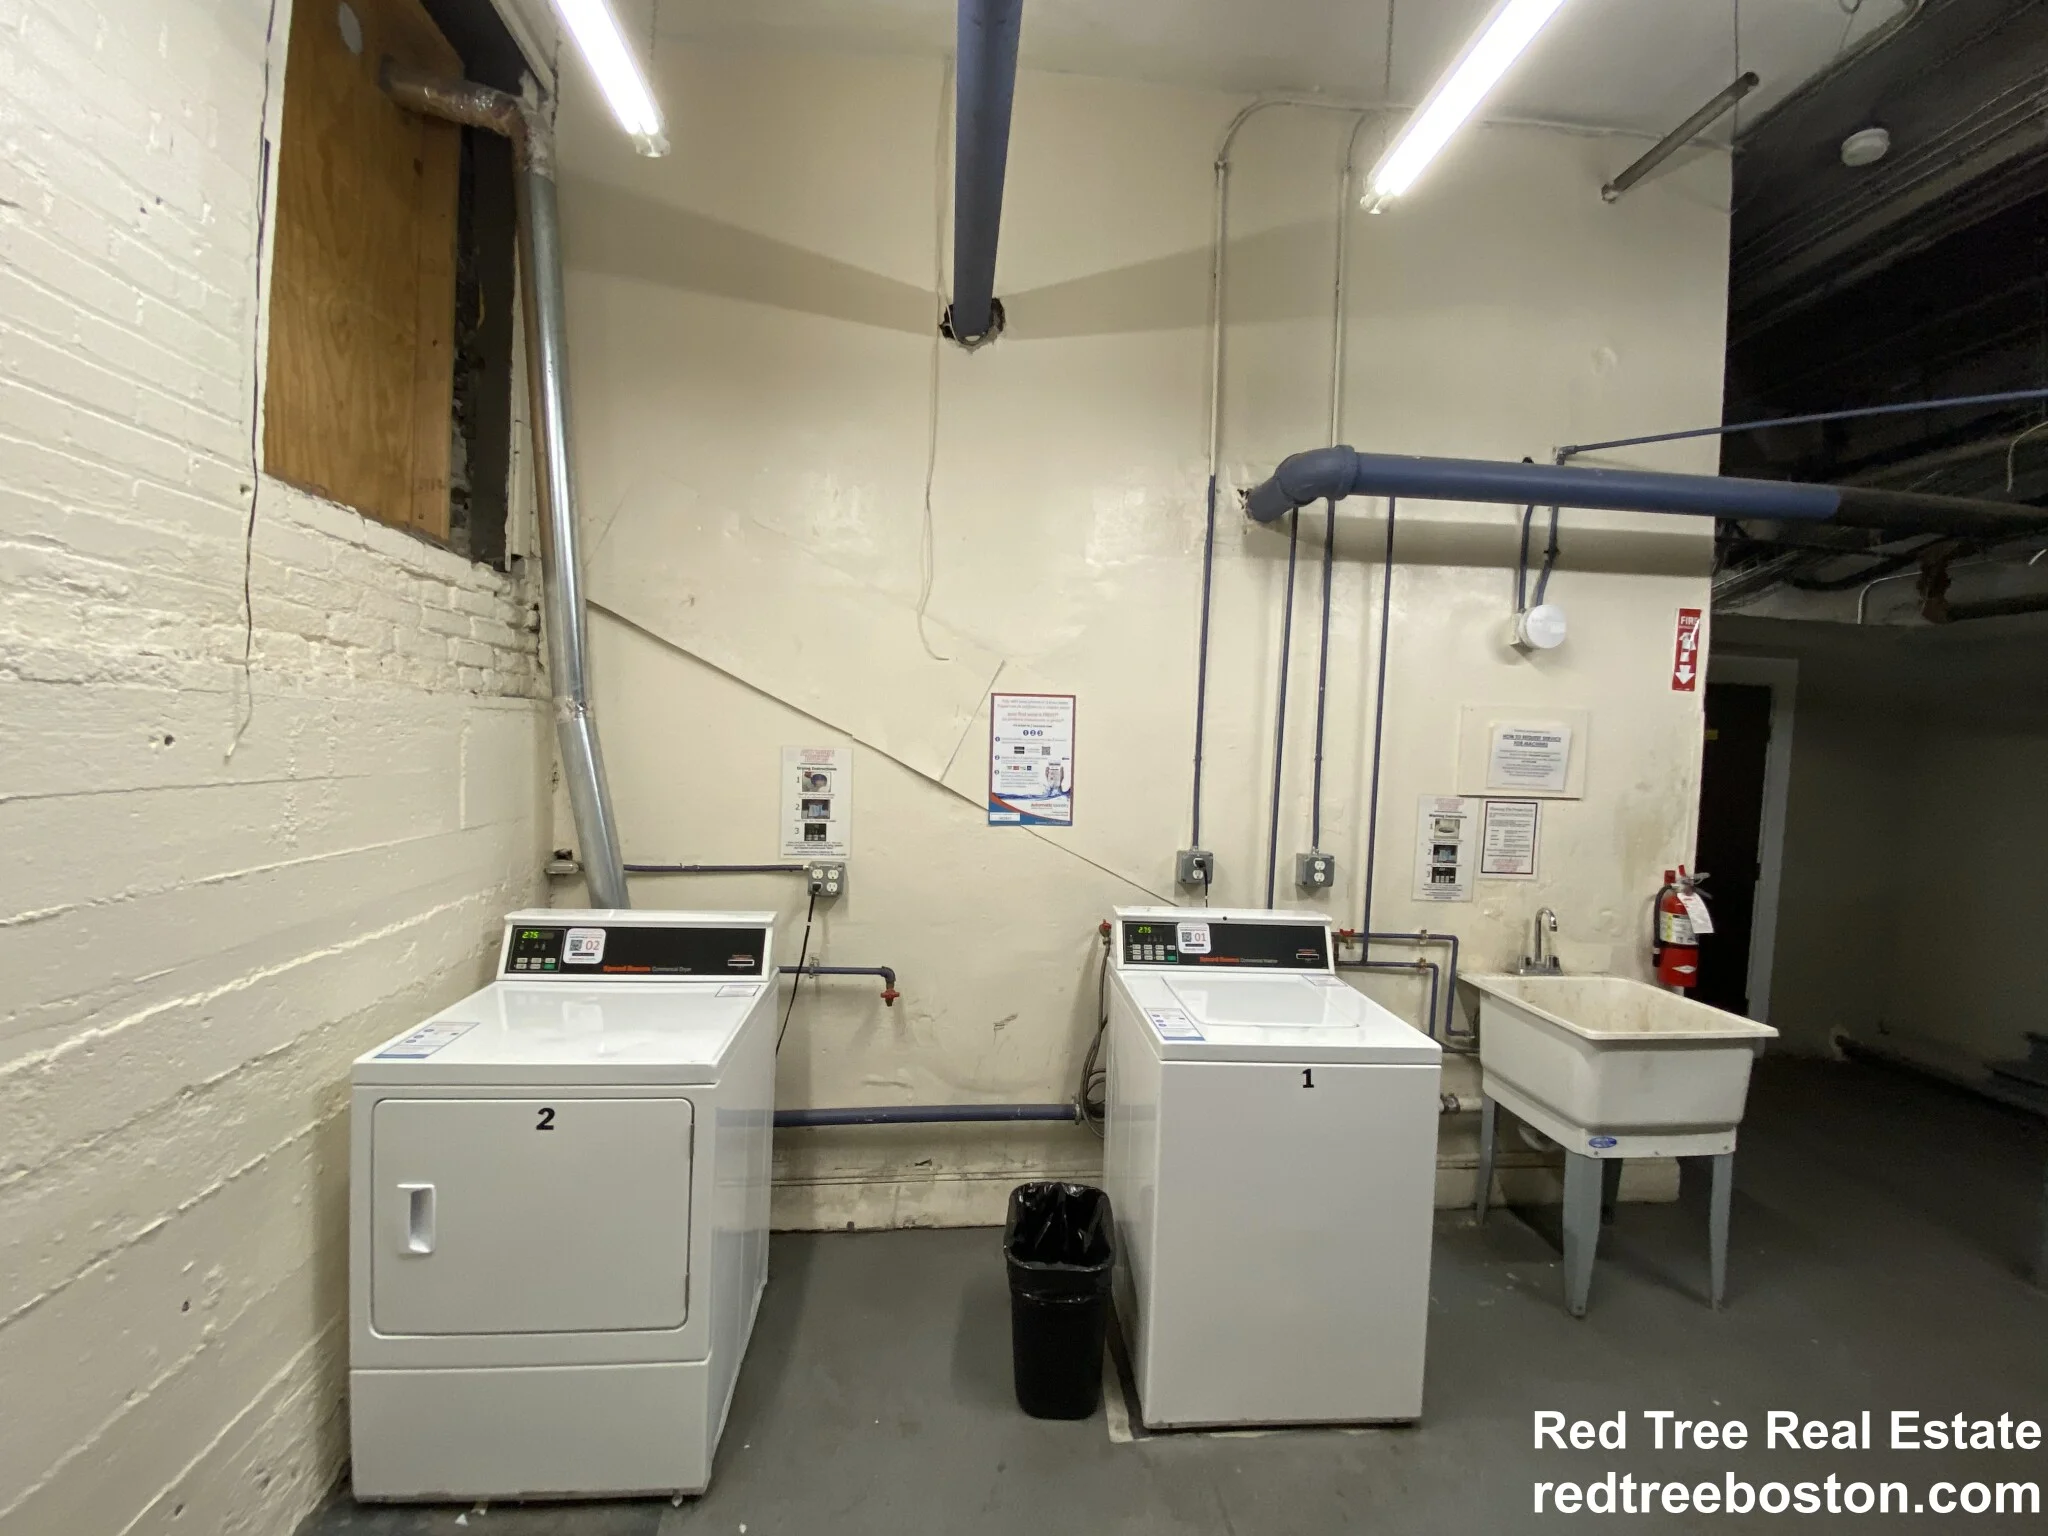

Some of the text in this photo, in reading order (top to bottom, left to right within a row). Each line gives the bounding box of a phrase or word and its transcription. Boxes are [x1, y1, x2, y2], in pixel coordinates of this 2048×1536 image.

[795, 803, 800, 811] 2
[1194, 932, 1207, 942] 01
[585, 940, 601, 951] 02
[1302, 1068, 1314, 1088] 1
[536, 1107, 555, 1130] 2
